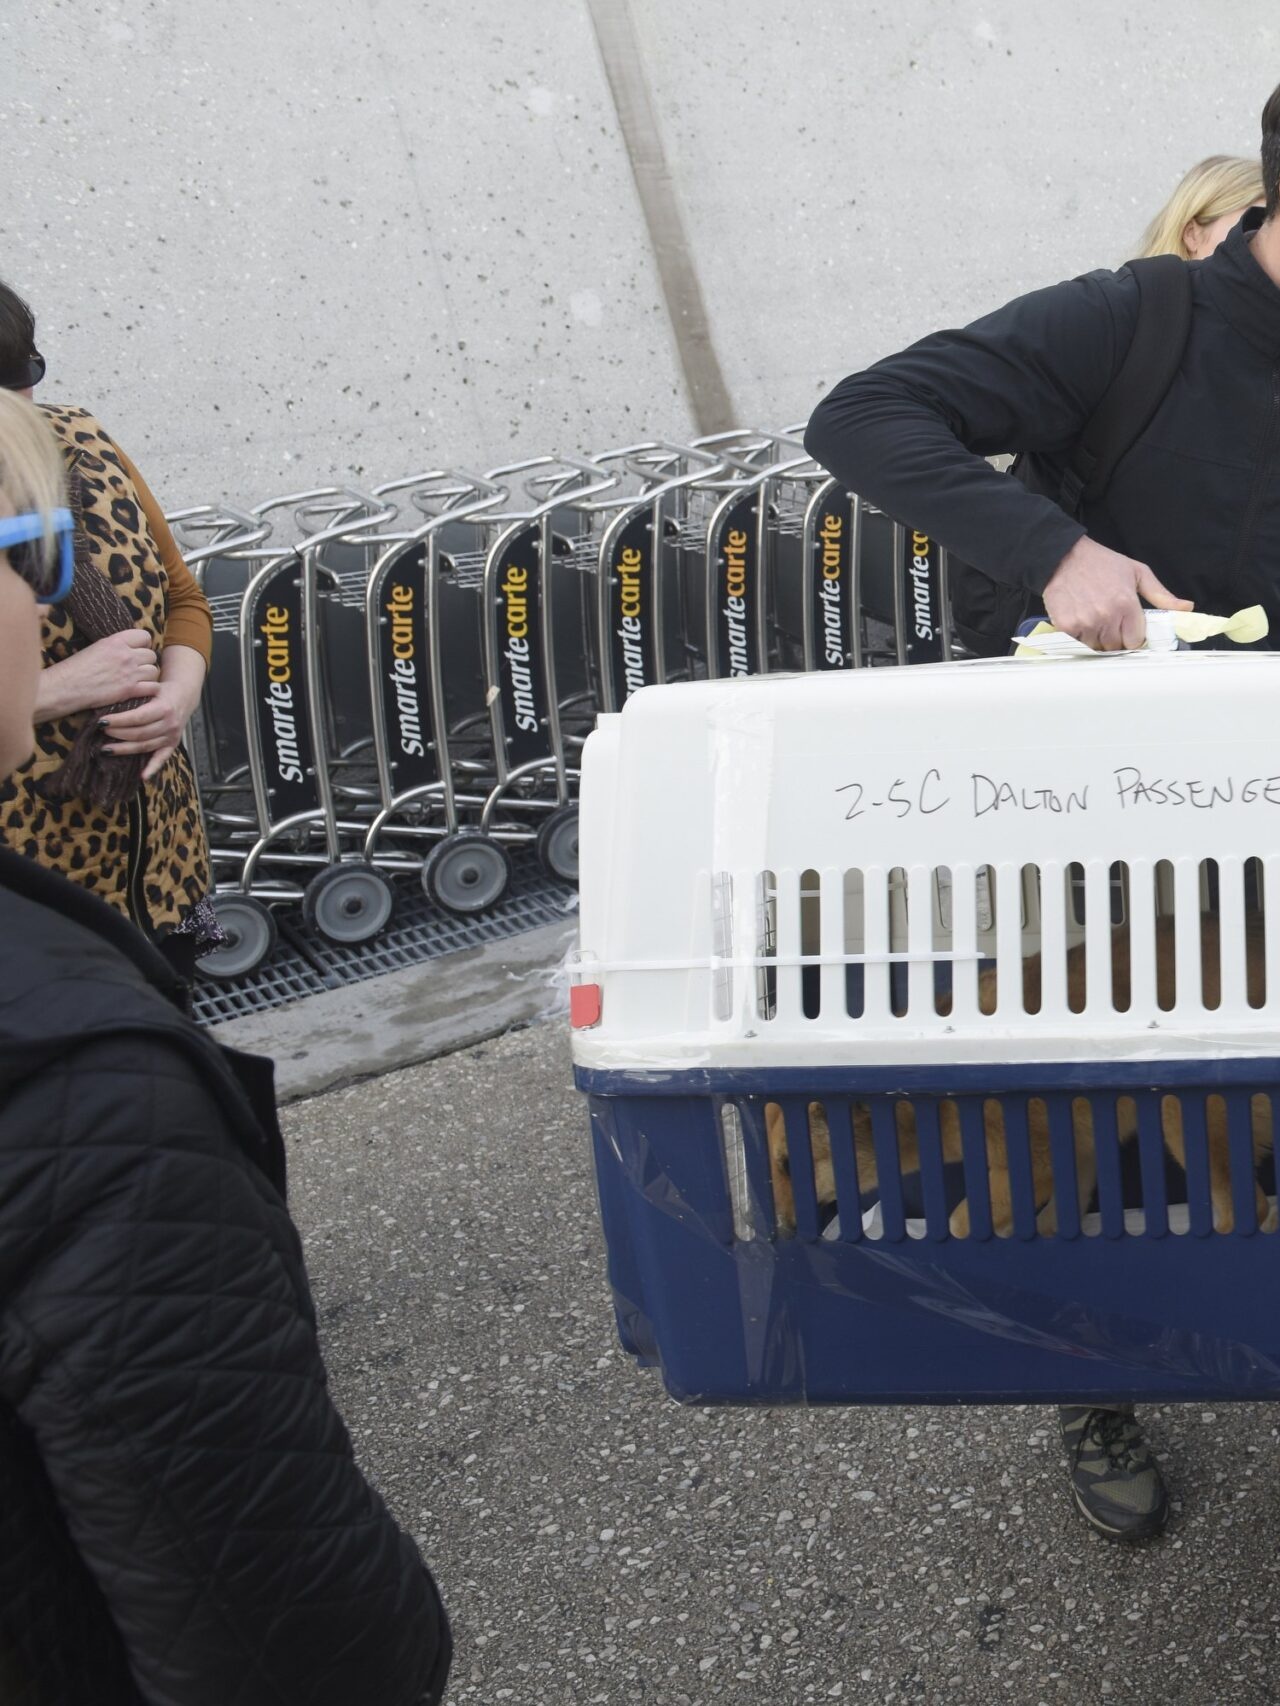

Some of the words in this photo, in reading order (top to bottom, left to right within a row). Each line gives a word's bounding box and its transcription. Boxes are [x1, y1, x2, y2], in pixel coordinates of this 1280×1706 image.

[387, 584, 425, 757] smartecarte
[502, 566, 538, 733] smartecarte
[818, 513, 843, 667] smartecarte
[260, 605, 304, 783] smartecarte
[835, 769, 950, 820] 2-5C
[971, 773, 1089, 818] DALTON
